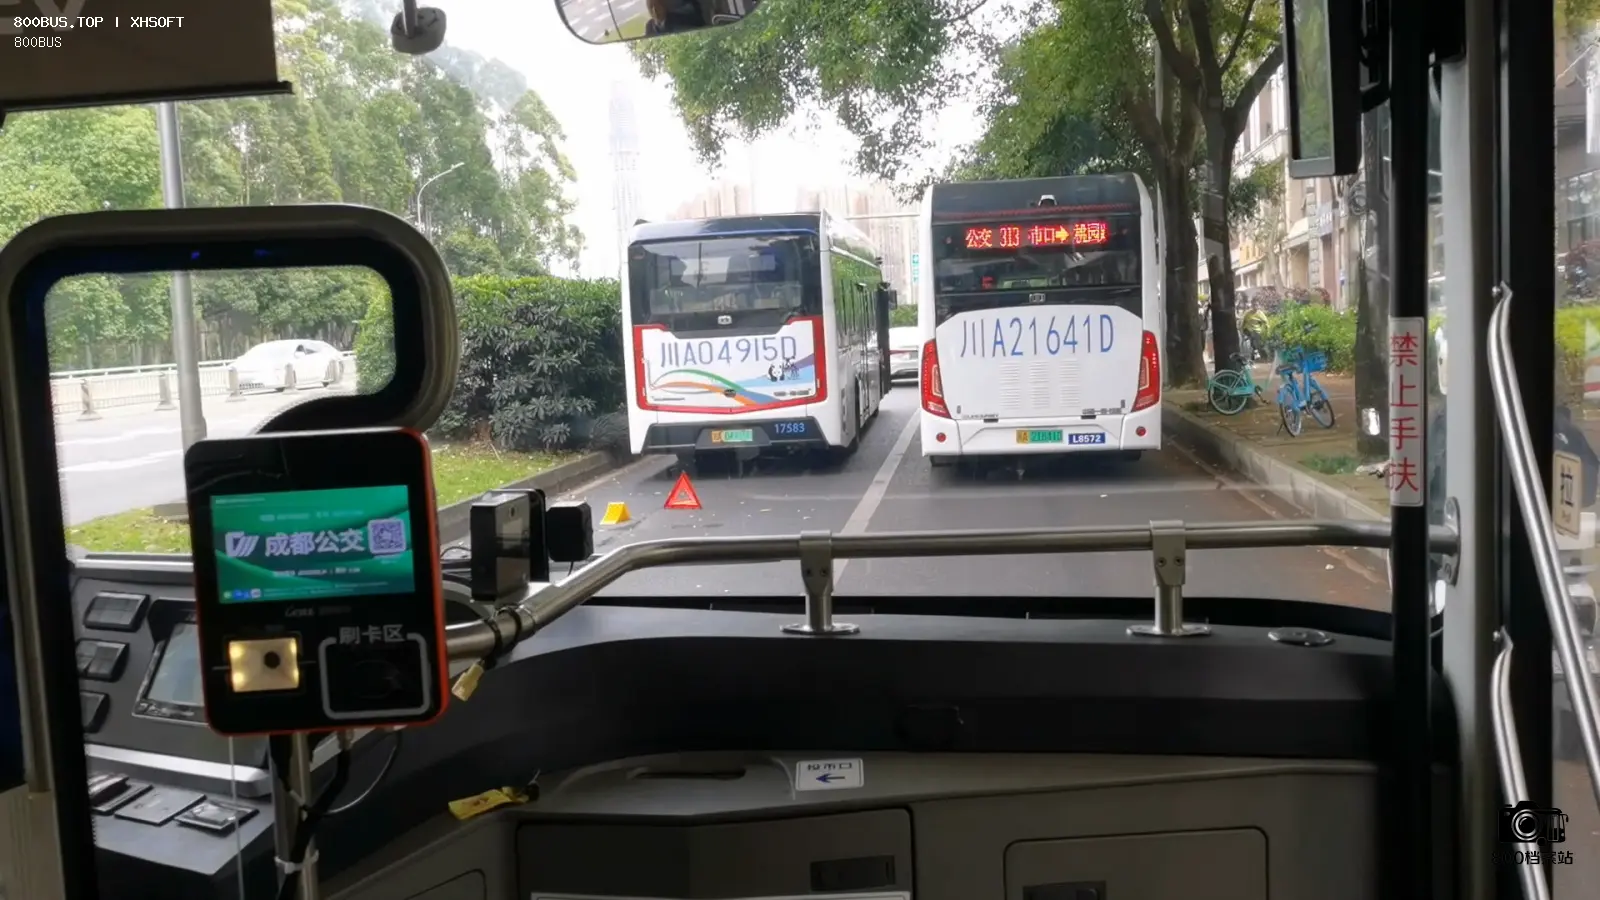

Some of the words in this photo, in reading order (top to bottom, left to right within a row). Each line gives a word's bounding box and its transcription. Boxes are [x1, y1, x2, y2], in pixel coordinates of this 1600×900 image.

[965, 228, 993, 248] 公交
[1000, 227, 1020, 247] 313
[960, 314, 1115, 358] 川A21641D
[660, 336, 797, 368] 川A04915D
[774, 422, 806, 434] 17583
[1072, 433, 1102, 444] L8572
[264, 528, 366, 557] 成都公交
[338, 624, 405, 645] 刷卡区
